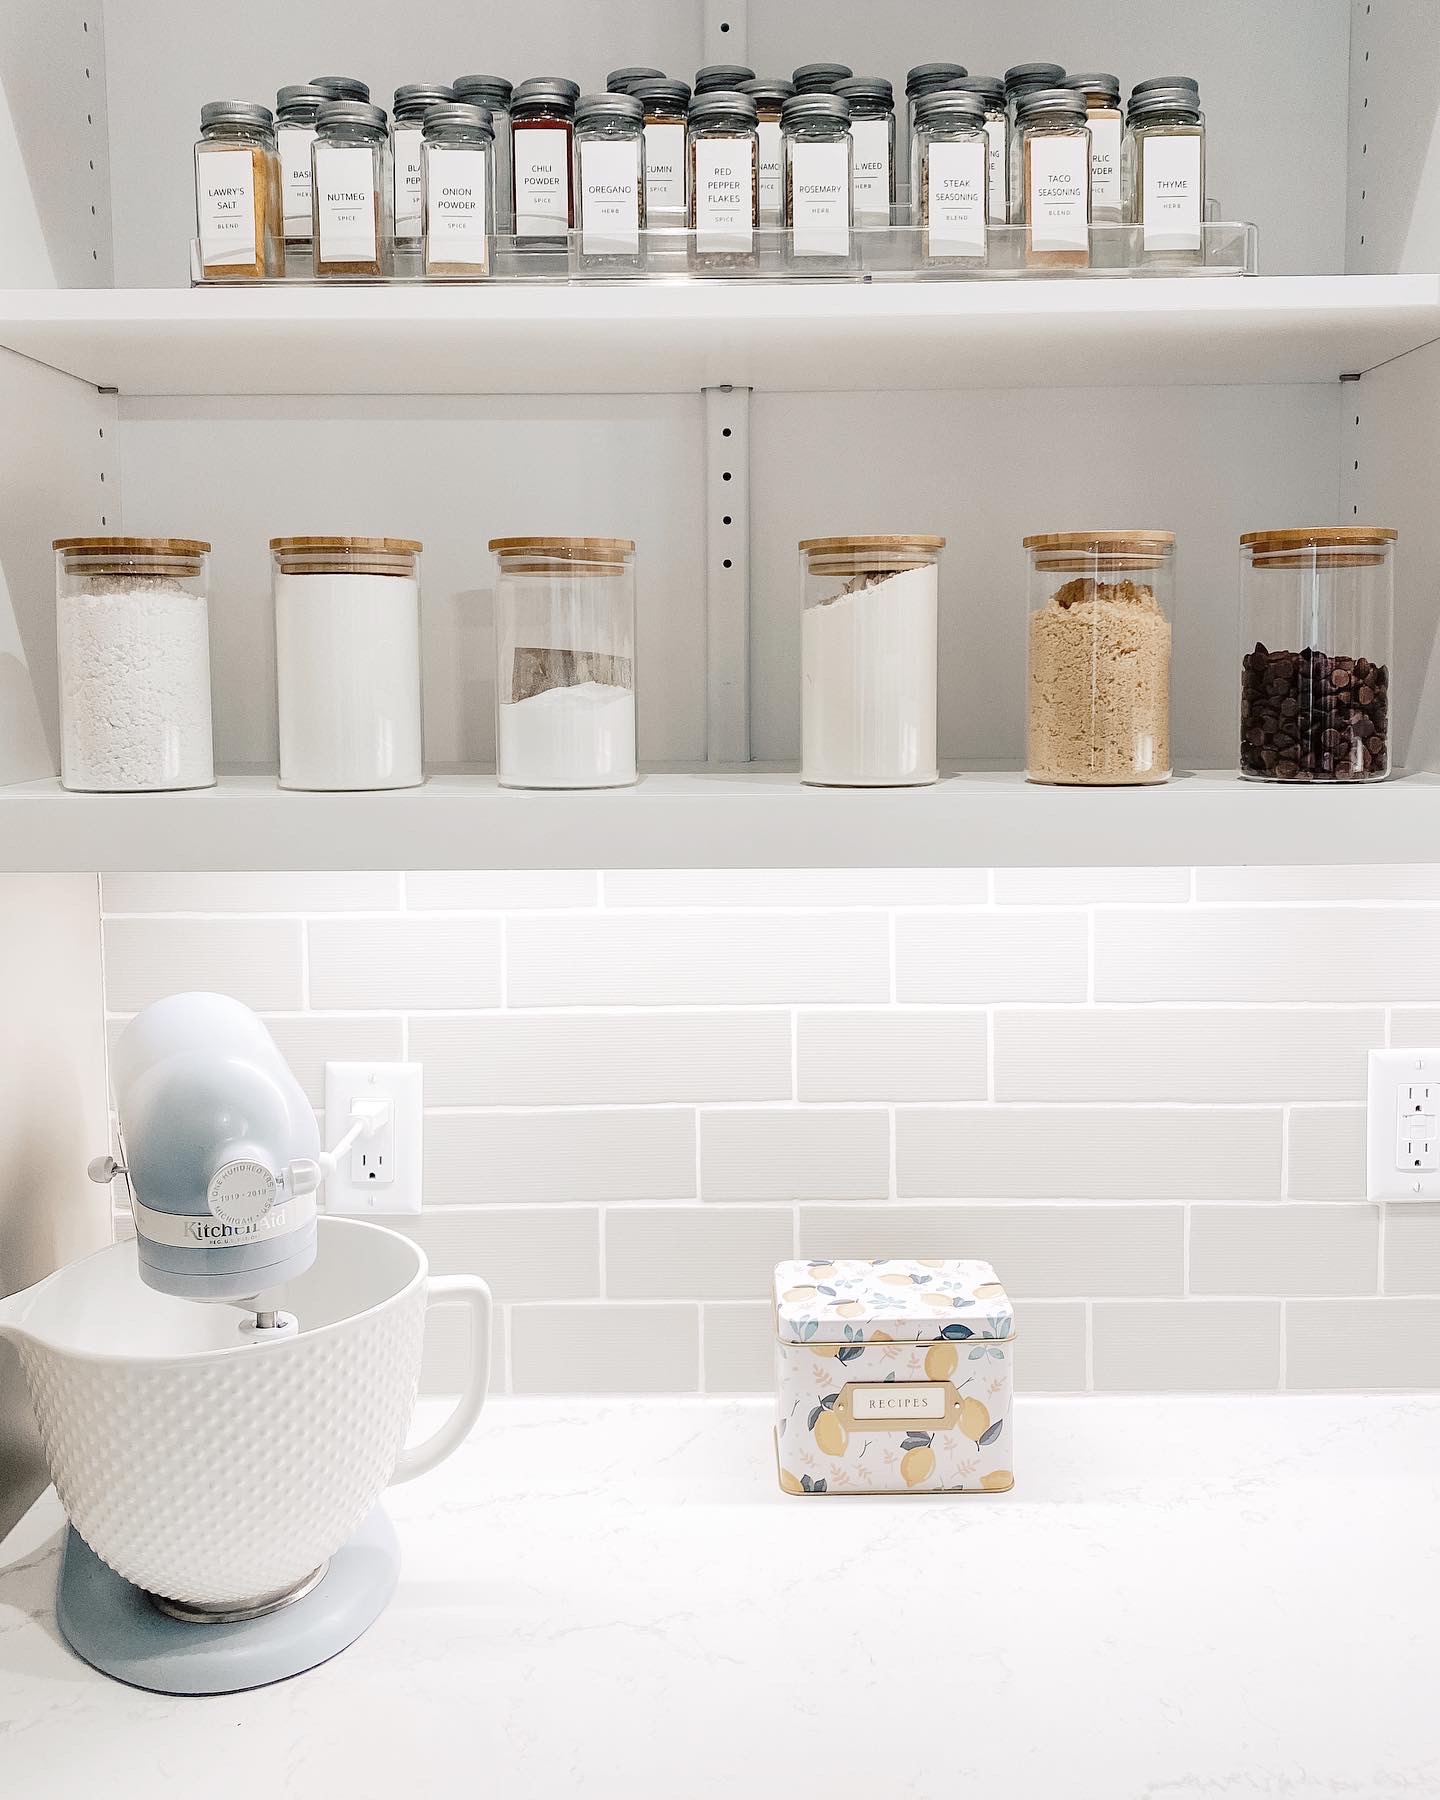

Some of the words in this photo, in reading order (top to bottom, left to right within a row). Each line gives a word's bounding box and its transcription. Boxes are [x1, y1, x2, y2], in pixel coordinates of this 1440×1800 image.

[1092, 154, 1110, 162] RLIC
[407, 164, 421, 172] BLA
[531, 165, 552, 173] CHILI
[646, 165, 673, 173] CUMIN
[861, 162, 883, 170] WEED
[293, 170, 312, 179] BASI
[714, 168, 732, 176] RED
[1091, 167, 1113, 175] WDER
[406, 177, 421, 185] PEP
[524, 177, 560, 185] POWDER
[1048, 175, 1071, 183] TACO
[708, 181, 740, 190] PEPPER
[943, 180, 970, 188] STEAK
[1157, 180, 1188, 189] THYME
[208, 187, 245, 197] LAWRY'S
[442, 187, 472, 196] ONION
[588, 185, 632, 194] OREGANO
[799, 185, 841, 194] ROSEMARY
[1038, 187, 1081, 197] SEASONING
[327, 192, 365, 202] NUTMEG
[708, 195, 741, 203] FLAKES
[935, 193, 979, 201] SEASONING
[217, 201, 237, 210] SALT
[438, 200, 476, 209] POWDER
[184, 1208, 286, 1241] KitchenAid
[869, 1398, 928, 1409] RECIPES
